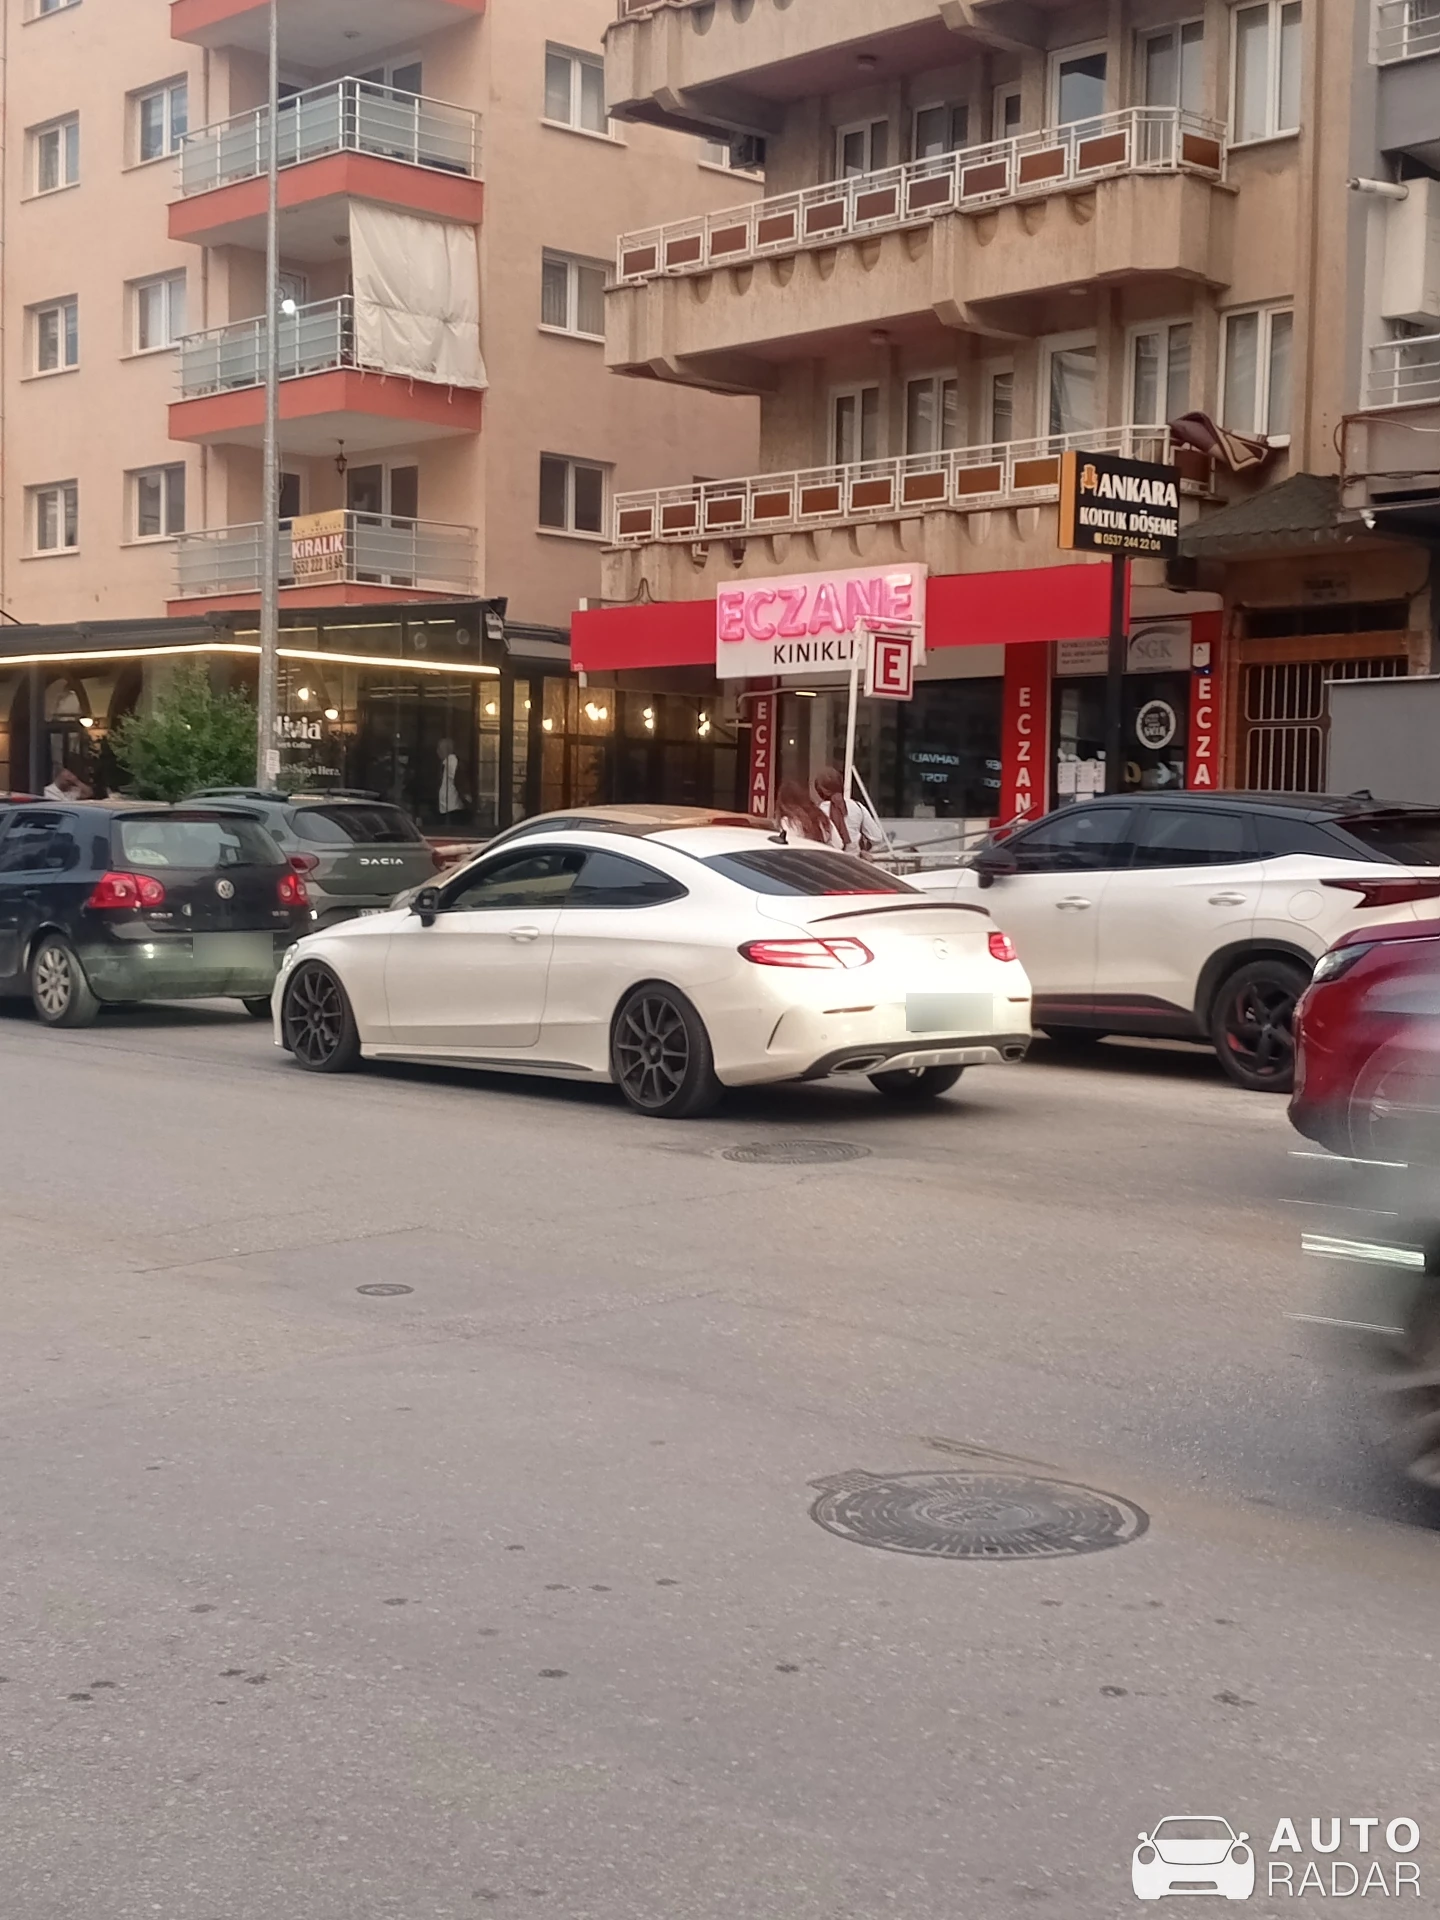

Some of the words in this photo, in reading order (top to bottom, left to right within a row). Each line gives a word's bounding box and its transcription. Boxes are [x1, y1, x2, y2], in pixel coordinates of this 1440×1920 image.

[1098, 473, 1178, 508] ANKARA
[1080, 506, 1127, 530] KOLTUK
[1129, 509, 1178, 538] DÖŞEME
[1103, 534, 1122, 546] 0537
[1124, 536, 1139, 548] 244
[1140, 538, 1150, 550] 22
[1150, 539, 1161, 551] 04
[311, 557, 323, 573] 222
[719, 573, 913, 642] ECZANE
[774, 640, 854, 664] KINIKLI
[1135, 639, 1173, 659] SGK
[883, 647, 901, 685] E
[1194, 678, 1212, 785] ECZA
[752, 701, 767, 813] ECZAN
[359, 857, 404, 866] DACIA
